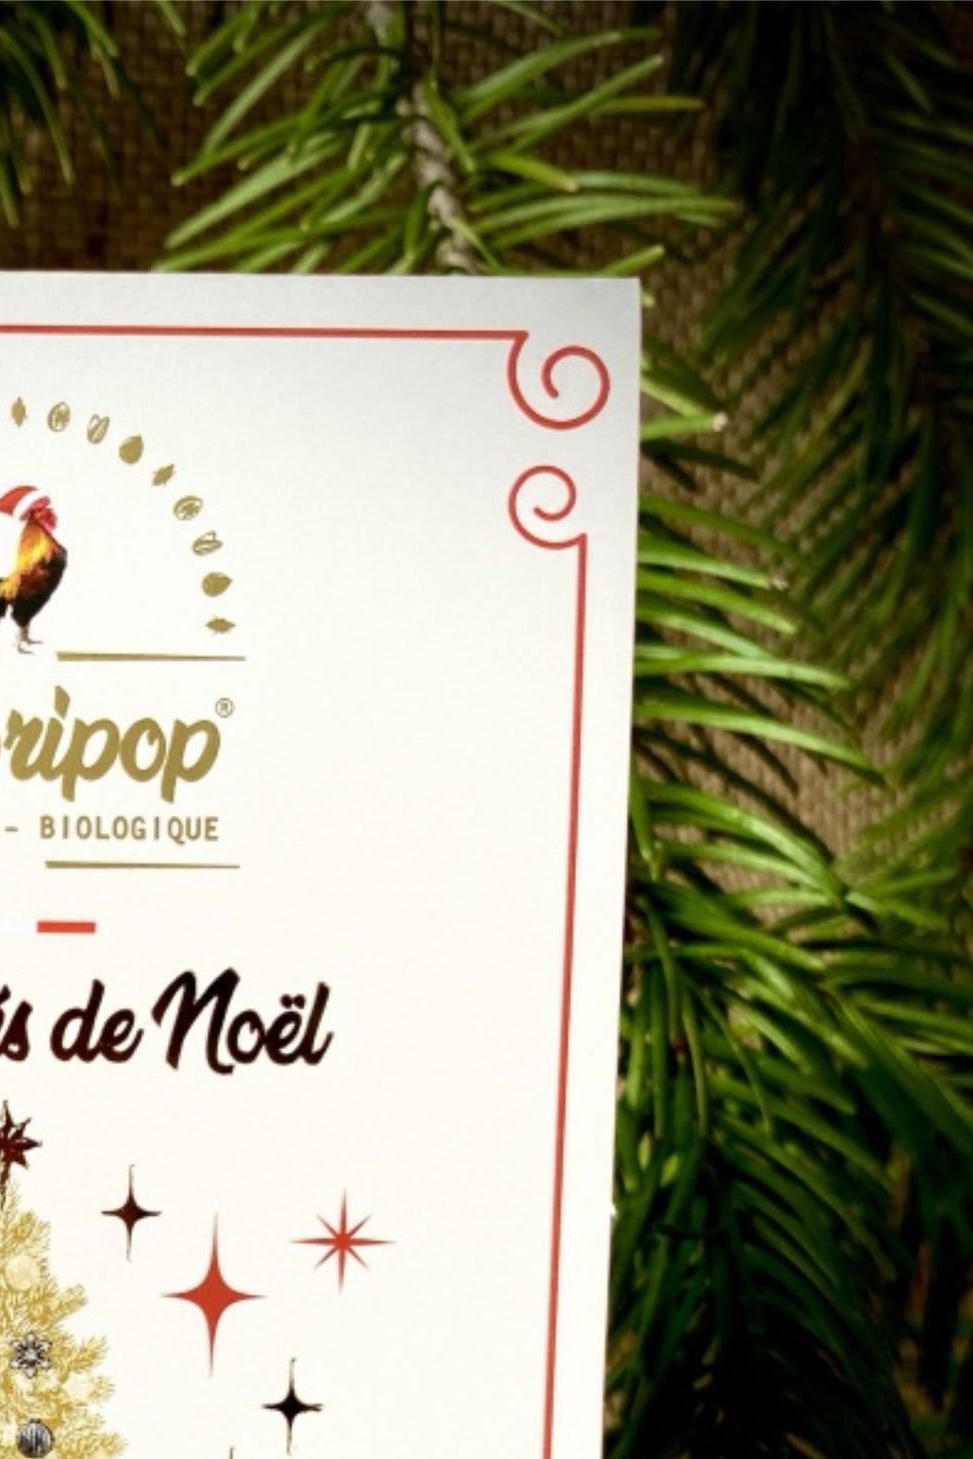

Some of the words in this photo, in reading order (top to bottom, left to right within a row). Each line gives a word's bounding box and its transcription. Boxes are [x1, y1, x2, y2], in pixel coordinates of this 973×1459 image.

[40, 816, 219, 845] BIOLOGIQUE
[49, 978, 144, 1062] de
[151, 966, 334, 1075] Noël
